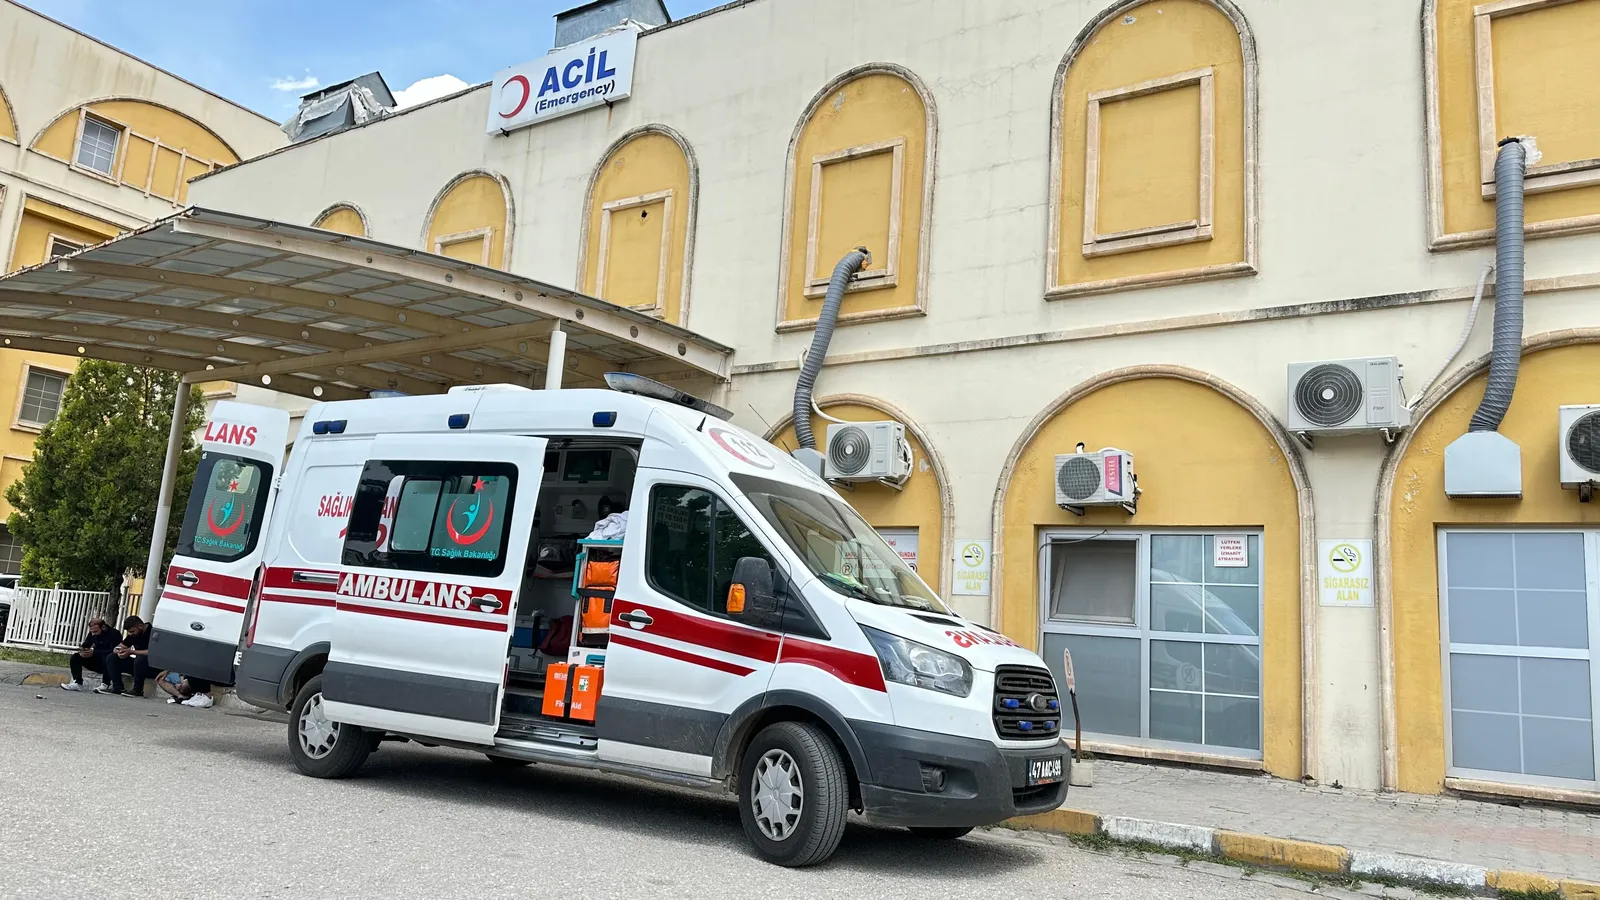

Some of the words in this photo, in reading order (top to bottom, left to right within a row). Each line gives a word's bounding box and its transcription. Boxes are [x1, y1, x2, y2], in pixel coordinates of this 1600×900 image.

[537, 47, 616, 97] ACİL
[535, 79, 616, 114] (Emergency)
[1108, 459, 1116, 486] VESTEL
[441, 548, 462, 559] Sağlık
[464, 550, 496, 561] Bakanlığı
[957, 570, 989, 580] SİGARASIZ
[965, 582, 981, 590] ALAN
[1323, 575, 1369, 589] SİGARASIZ
[337, 573, 473, 610] AMBULANS
[1336, 590, 1359, 601] ALAN
[571, 701, 582, 710] Aid
